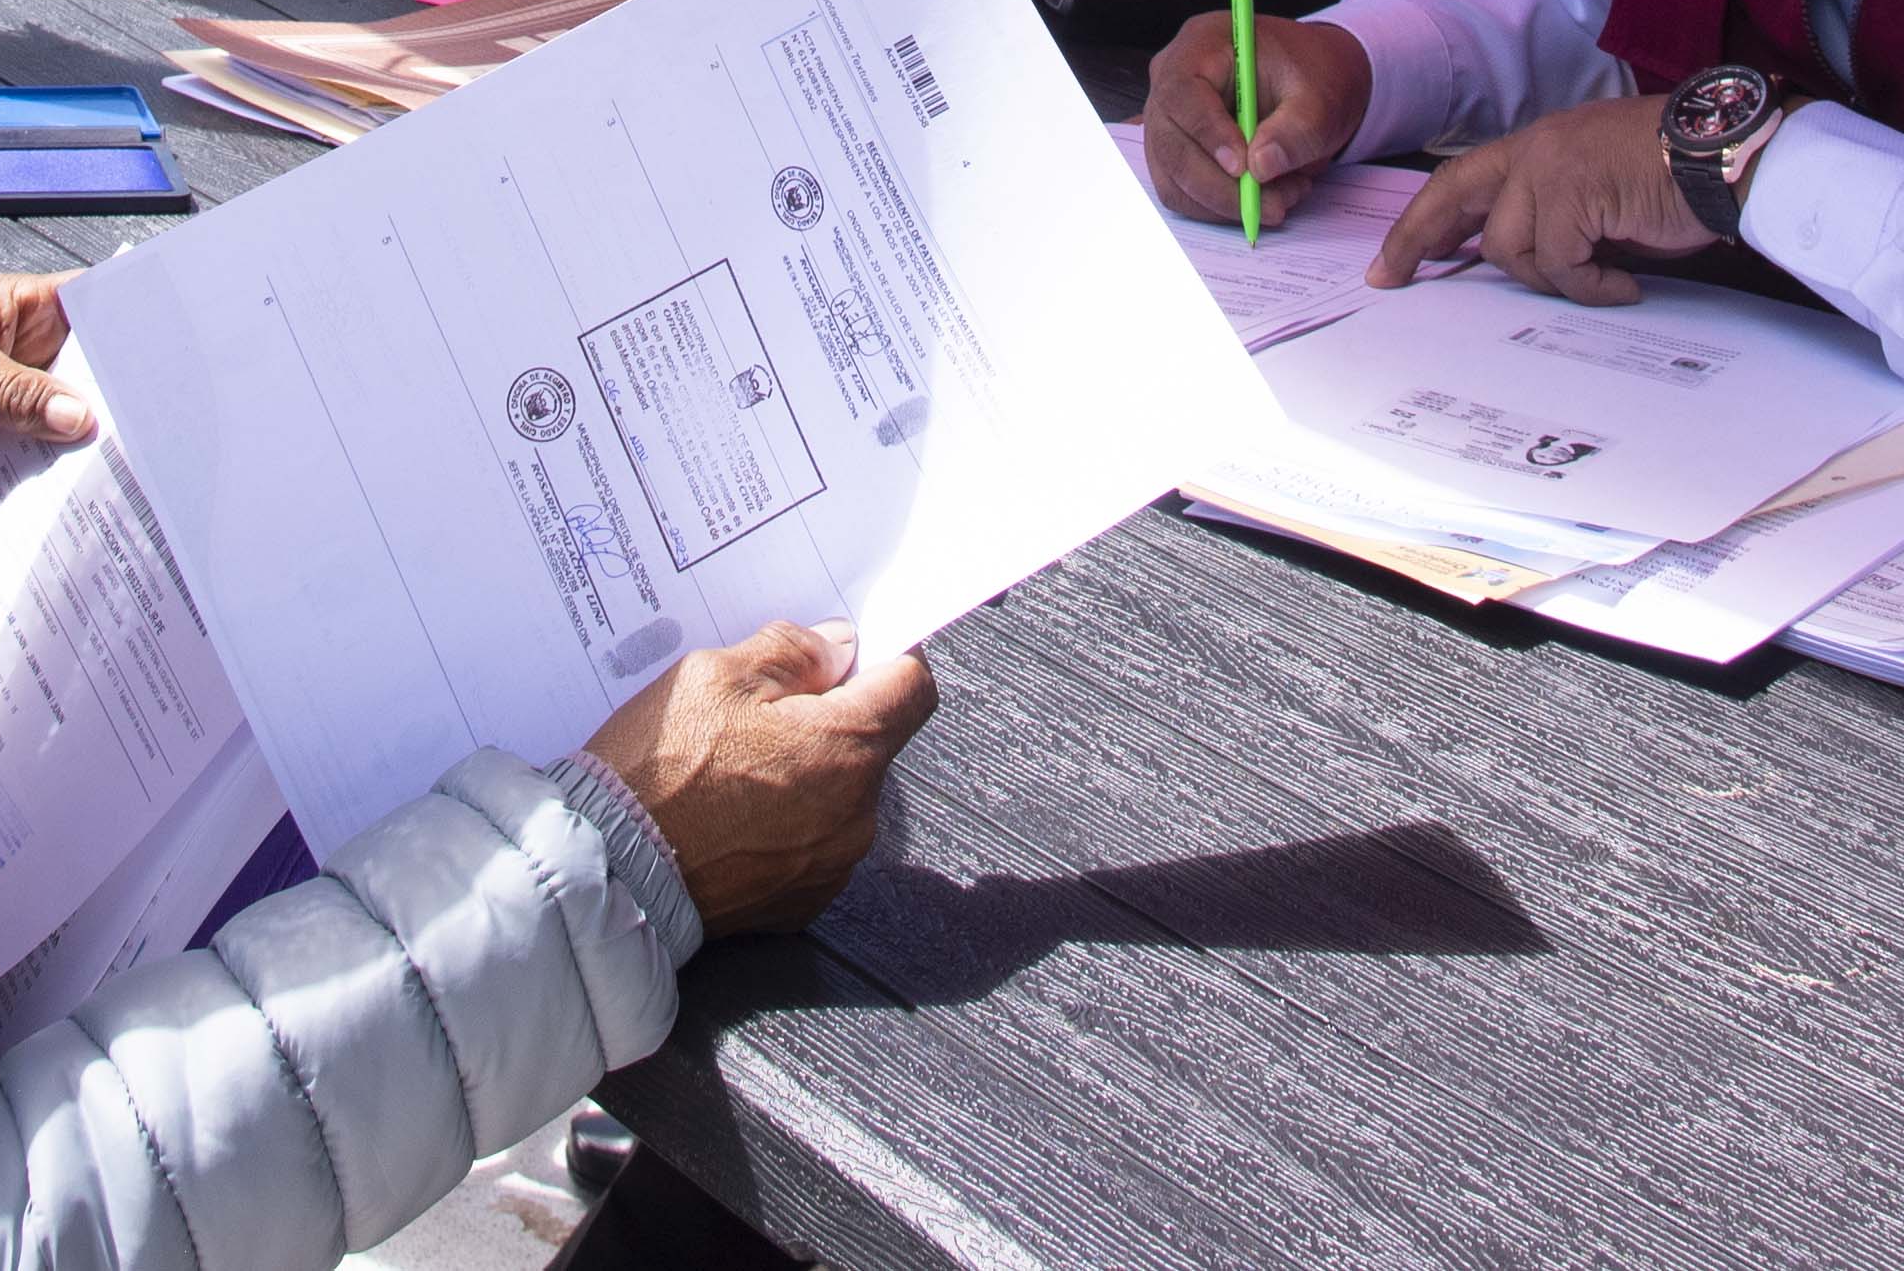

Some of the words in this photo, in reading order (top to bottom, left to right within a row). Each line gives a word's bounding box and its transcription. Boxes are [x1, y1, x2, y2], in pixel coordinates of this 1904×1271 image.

[779, 40, 798, 66] ABRIL
[792, 66, 807, 87] DEL
[802, 87, 818, 114] 2002.
[850, 52, 879, 103] Textuales
[883, 46, 899, 69] Acta
[901, 82, 930, 128] 70718258
[846, 209, 875, 259] ONDORES,
[870, 259, 882, 272] 20
[877, 273, 890, 288] DE
[884, 286, 903, 314] JULIO
[898, 315, 913, 333] DEL
[866, 141, 916, 229] RECONOCIMIENTO
[911, 229, 923, 243] DE
[918, 244, 955, 304] PATERNIDAD
[952, 304, 959, 314] Y
[87, 500, 121, 556] NOTIFICACION
[531, 463, 560, 520] ROSARIO
[558, 527, 589, 588] PALACIOS
[585, 593, 605, 627] LUNA
[576, 423, 613, 497] MUNICIPALIDAD
[608, 498, 633, 545] DISTRITAL
[628, 546, 640, 561] DE
[635, 563, 661, 612] ONDORES
